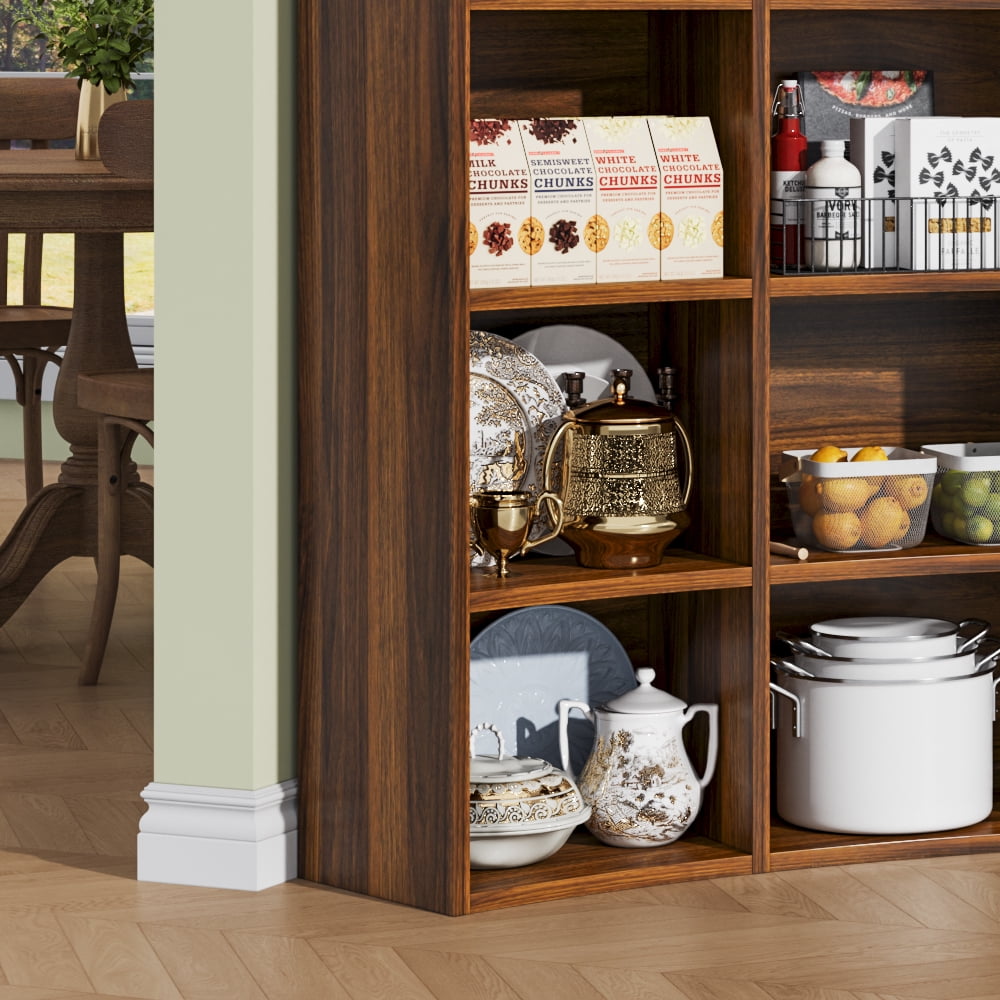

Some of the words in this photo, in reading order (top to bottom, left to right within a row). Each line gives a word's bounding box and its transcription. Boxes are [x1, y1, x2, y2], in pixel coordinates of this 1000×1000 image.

[595, 156, 636, 164] WHITE
[660, 154, 700, 162] WHITE
[534, 178, 594, 188] CHUNKS
[599, 176, 658, 186] CHUNKS
[664, 174, 720, 184] CHUNKS
[470, 179, 528, 190] CHUNKS
